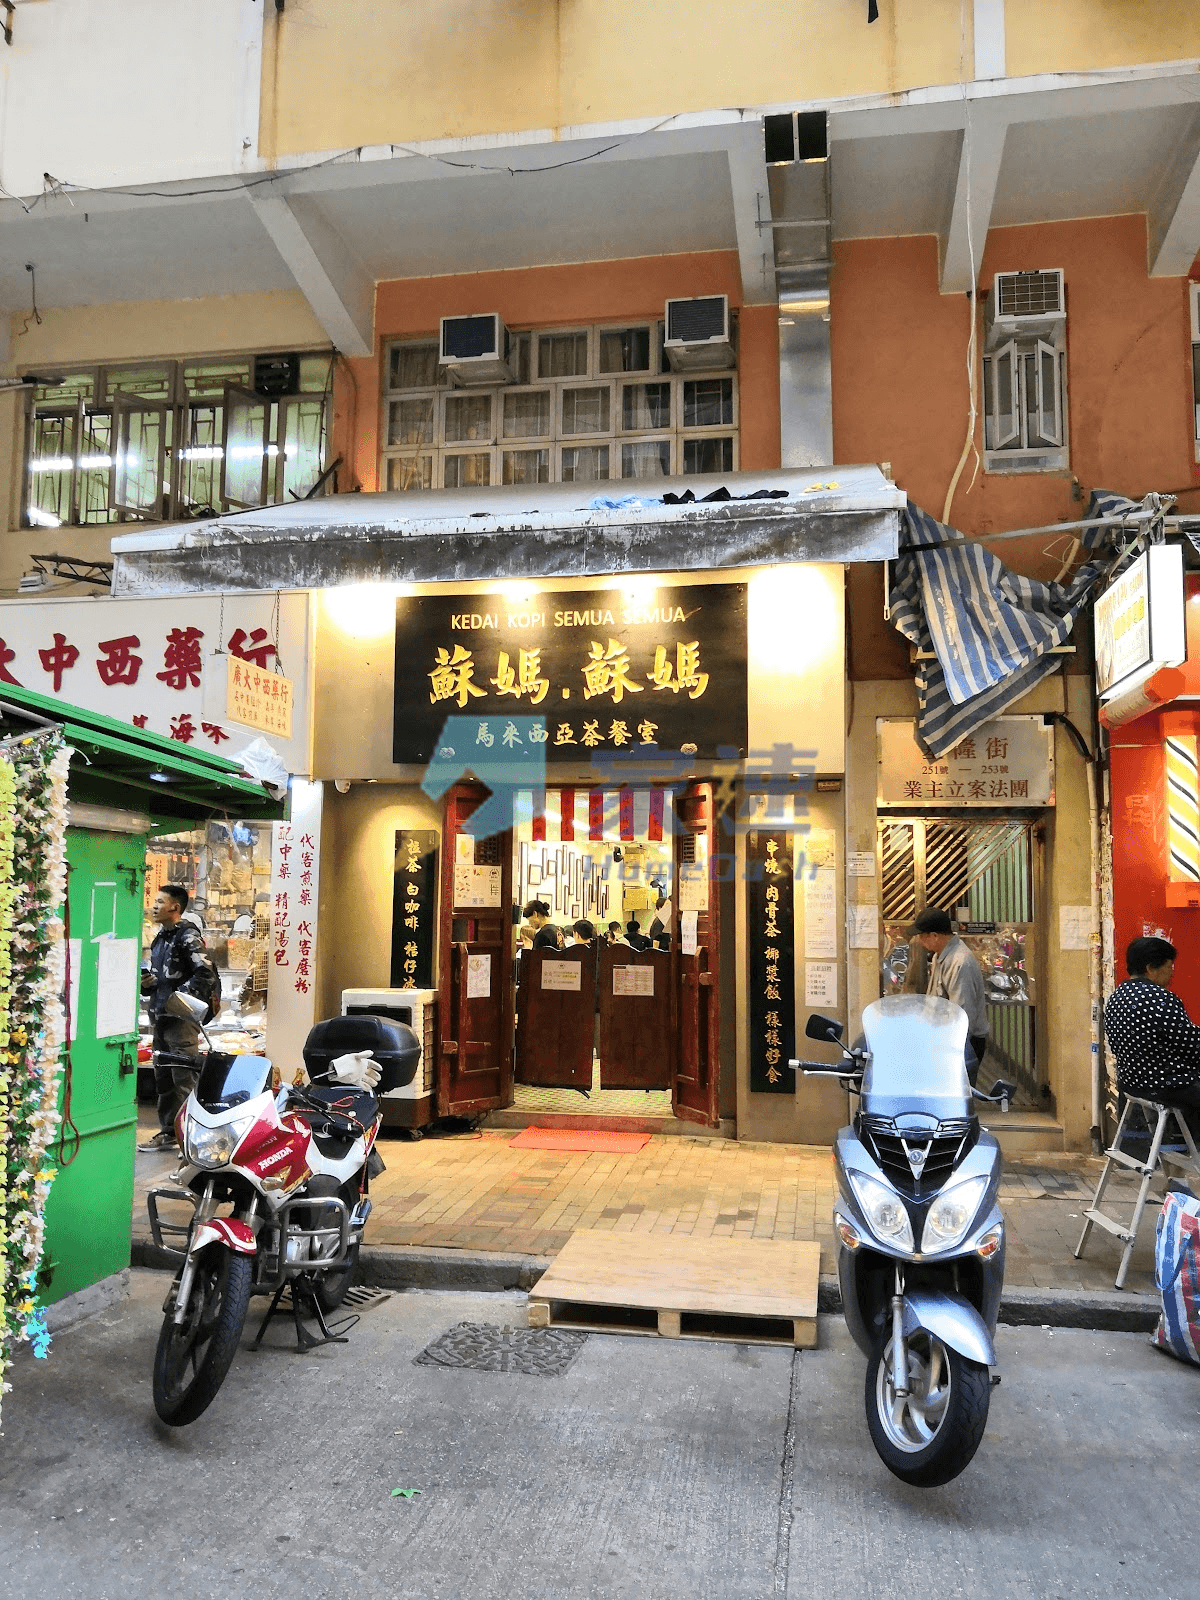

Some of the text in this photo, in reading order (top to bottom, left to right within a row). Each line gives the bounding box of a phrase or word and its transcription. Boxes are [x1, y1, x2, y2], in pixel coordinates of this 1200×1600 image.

[450, 606, 687, 629] KEDAI KOPI SEMUA SEMUA
[474, 719, 660, 748] 馬來西亞茶餐室
[922, 765, 949, 775] 251號
[981, 765, 1009, 775] 253號
[902, 779, 1029, 799] 業主立案法團
[404, 881, 420, 933] 白咖啡
[257, 1146, 294, 1171] HONDA
